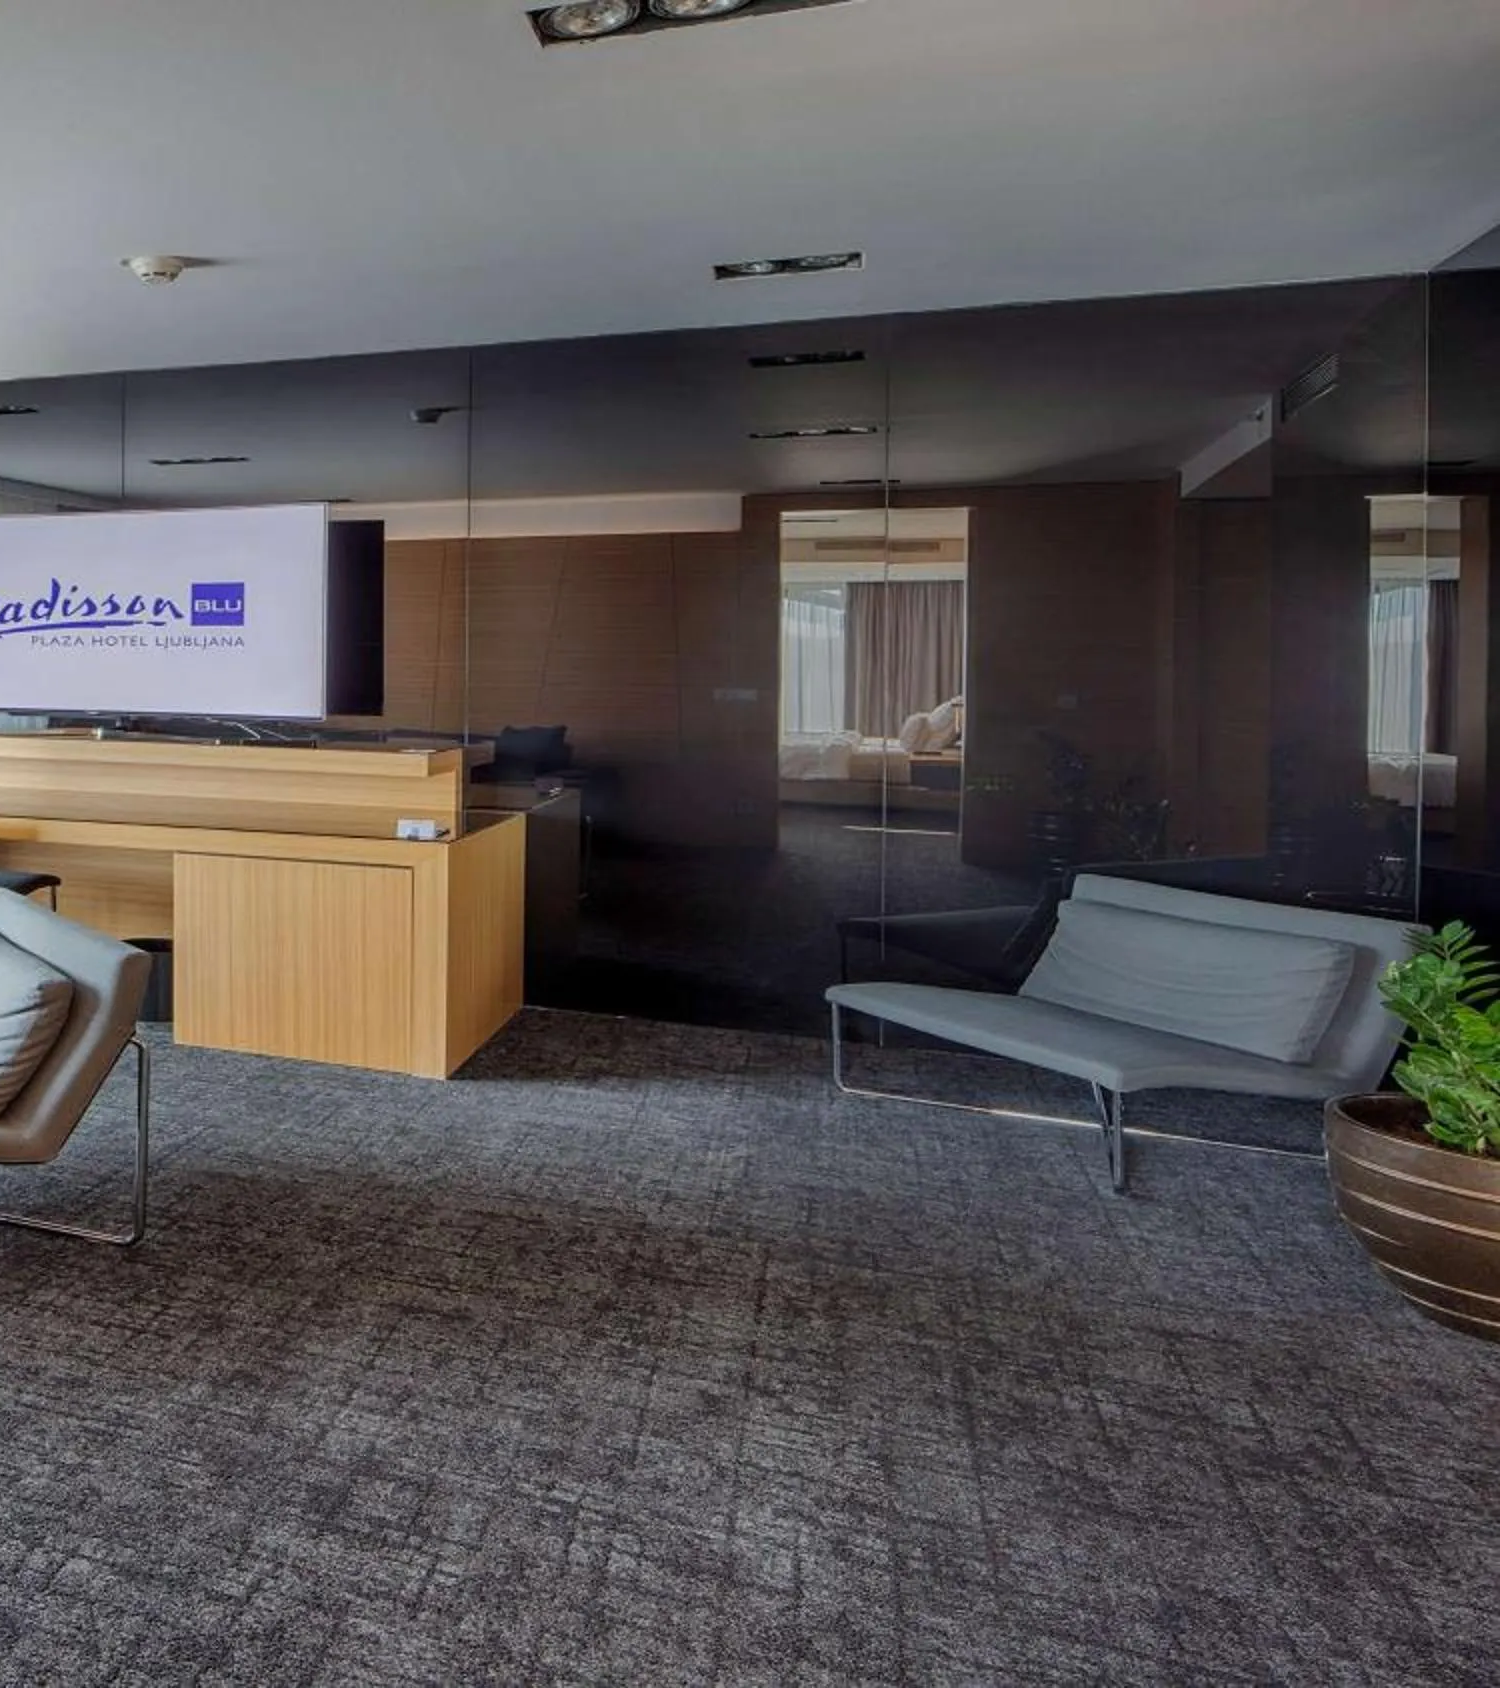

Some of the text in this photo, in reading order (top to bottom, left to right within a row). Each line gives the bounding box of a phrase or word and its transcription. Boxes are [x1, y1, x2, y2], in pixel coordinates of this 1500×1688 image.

[195, 600, 242, 612] BLU
[31, 635, 245, 649] PLAZA HOTEL LJUBLJANA
